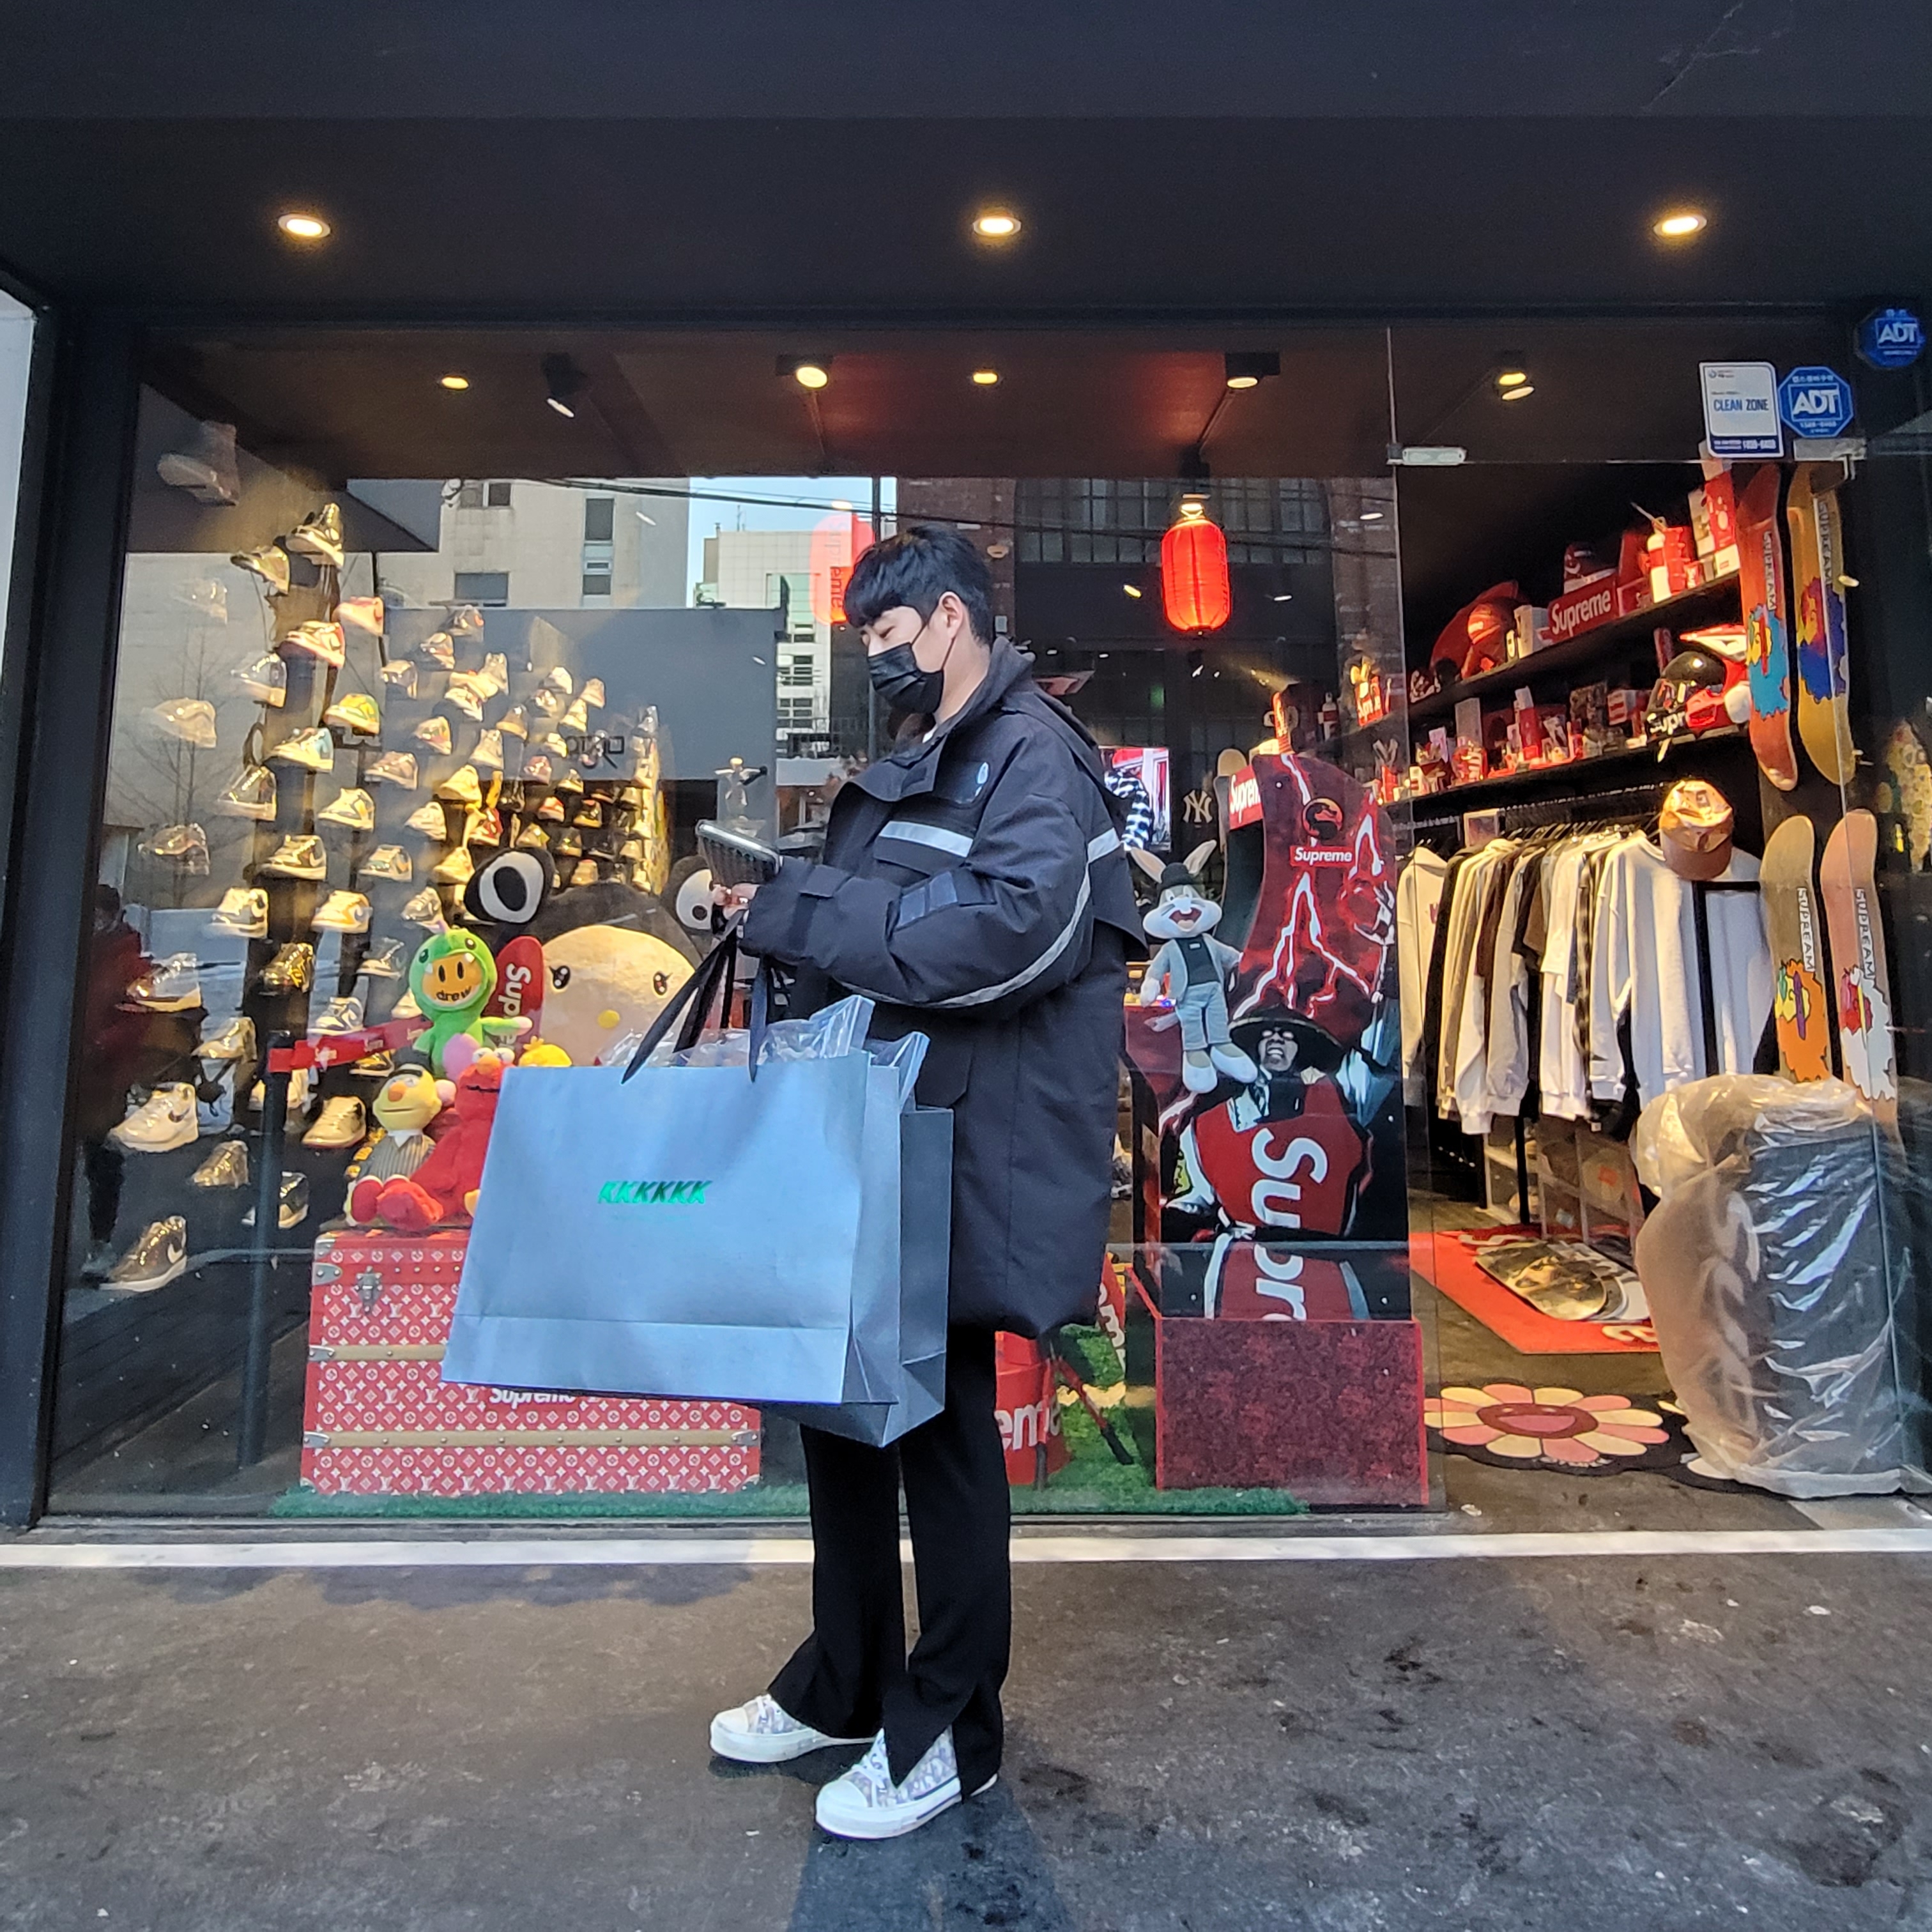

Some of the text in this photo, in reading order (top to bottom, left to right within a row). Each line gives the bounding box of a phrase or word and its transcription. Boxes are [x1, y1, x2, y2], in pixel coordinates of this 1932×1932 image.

[1878, 323, 1918, 343] ADT
[1713, 399, 1769, 411] CLEAN ZONE
[1793, 389, 1839, 415] ADT
[1551, 590, 1611, 637] Supreme
[1230, 774, 1261, 824] Suprem
[1294, 847, 1353, 866] Supreme
